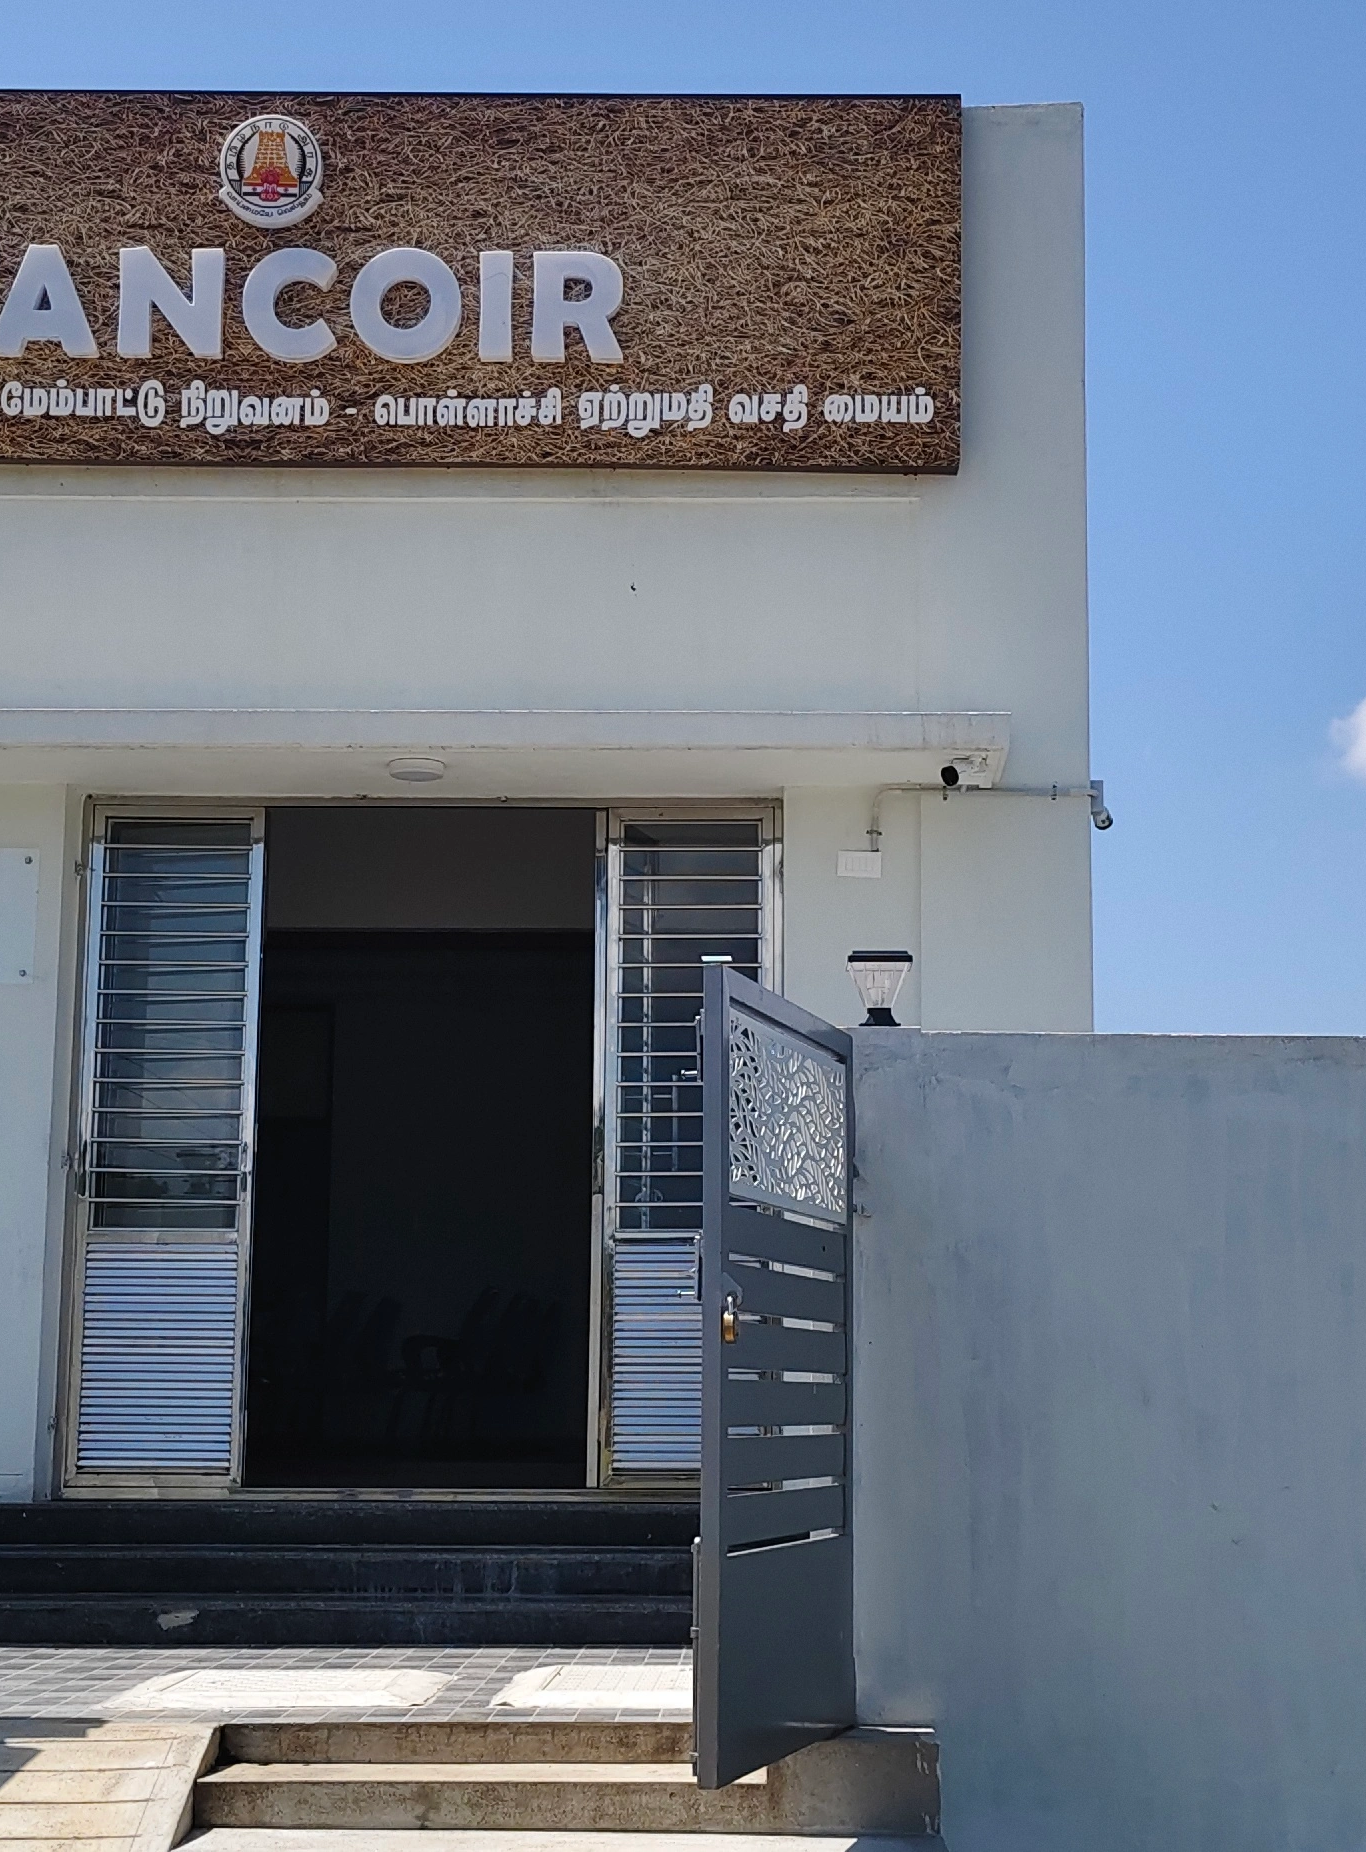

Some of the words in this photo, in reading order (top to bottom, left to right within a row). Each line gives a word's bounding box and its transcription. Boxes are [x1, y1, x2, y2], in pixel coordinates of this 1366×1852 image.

[1, 379, 165, 427] மேம்பாட்டு
[181, 380, 329, 434] நிறுவனம்
[375, 388, 562, 427] பொள்ளாச்சி
[579, 383, 714, 437] ஏற்றுமதி
[729, 384, 808, 432] வசதி
[824, 387, 934, 423] மையம்
